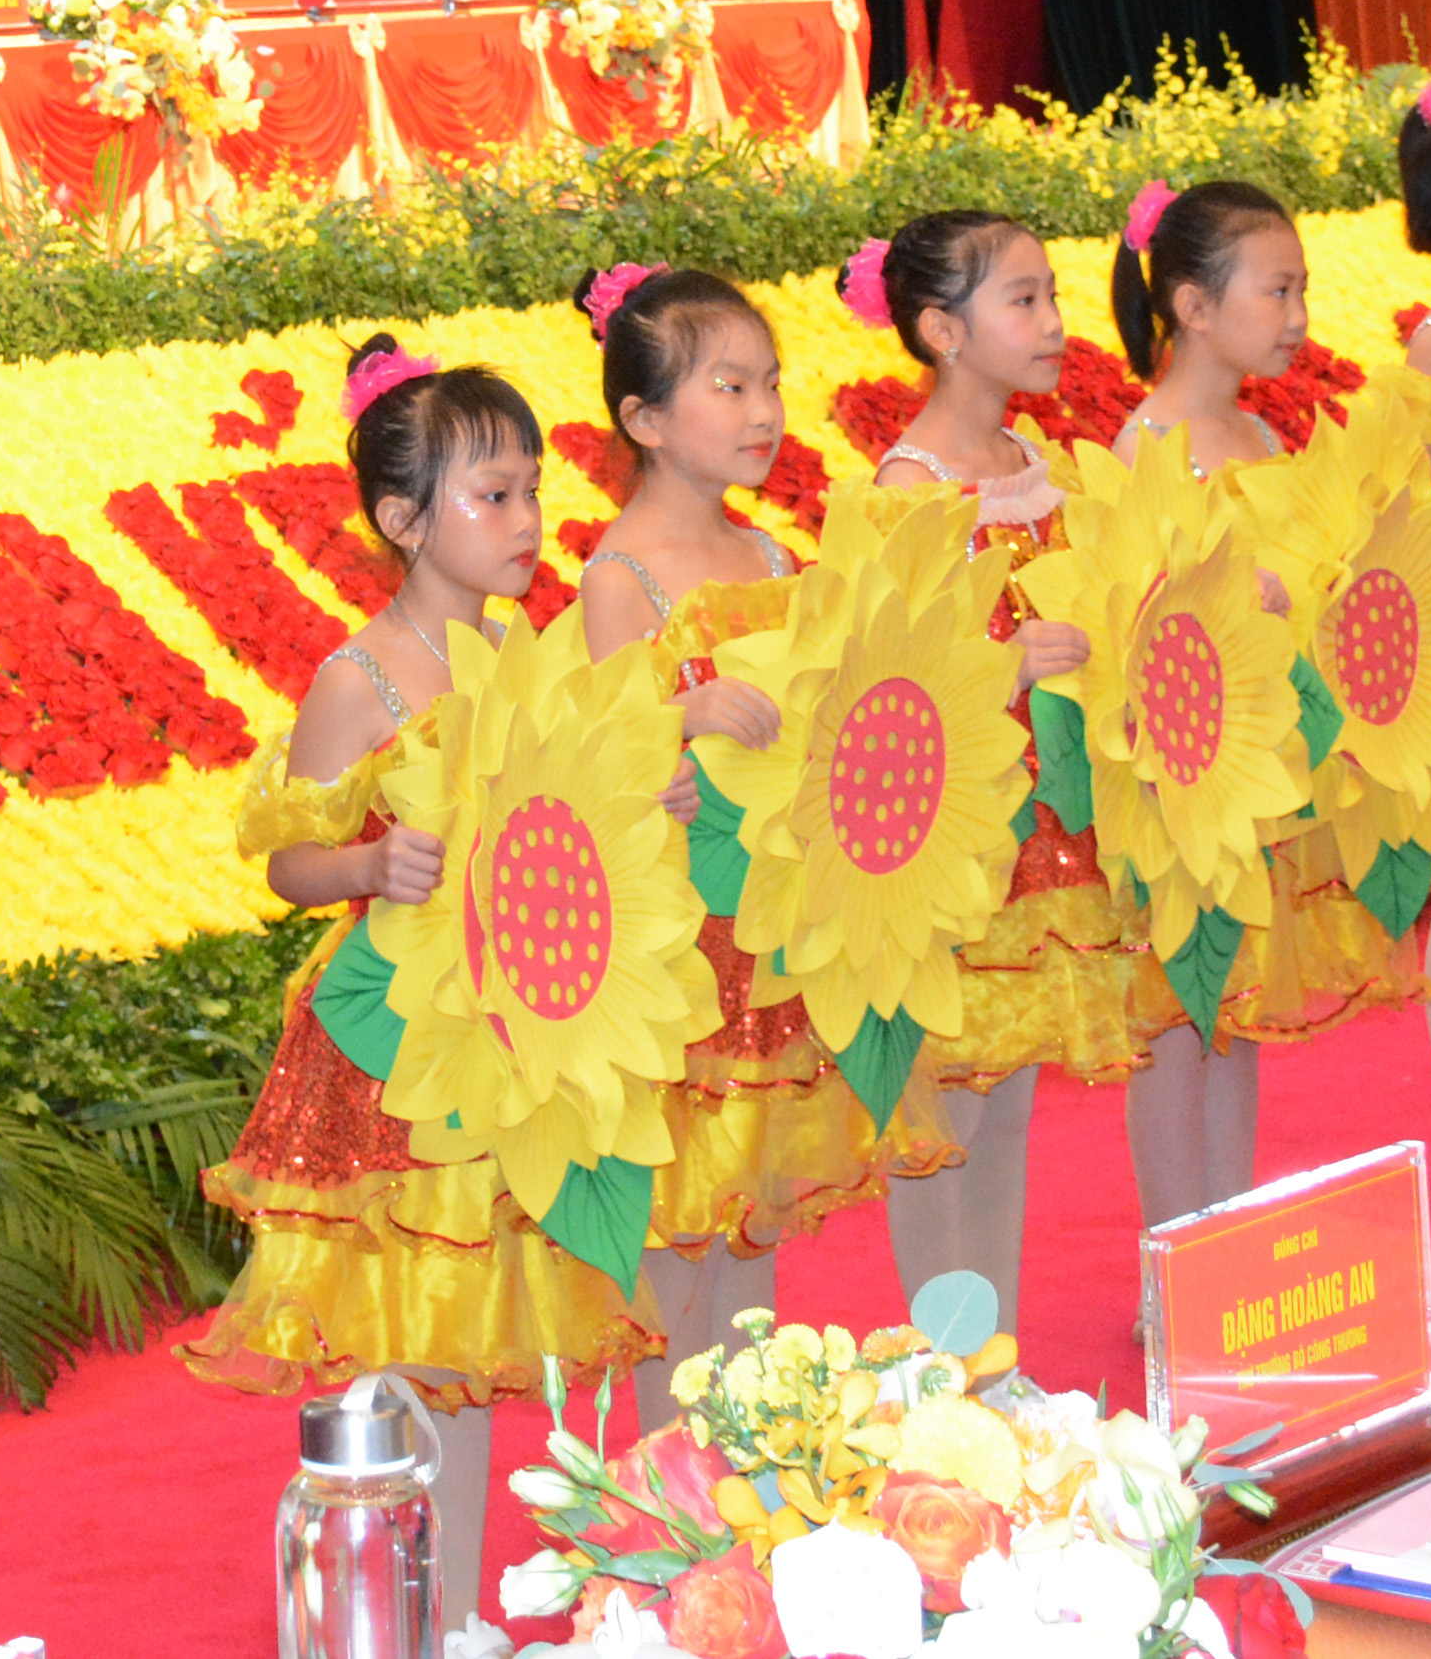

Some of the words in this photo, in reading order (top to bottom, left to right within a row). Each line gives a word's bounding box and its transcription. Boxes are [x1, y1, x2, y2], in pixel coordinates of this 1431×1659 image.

[1222, 1297, 1276, 1358] ĐẶNG
[1279, 1272, 1345, 1333] HOÀNG
[1349, 1259, 1376, 1308] AN
